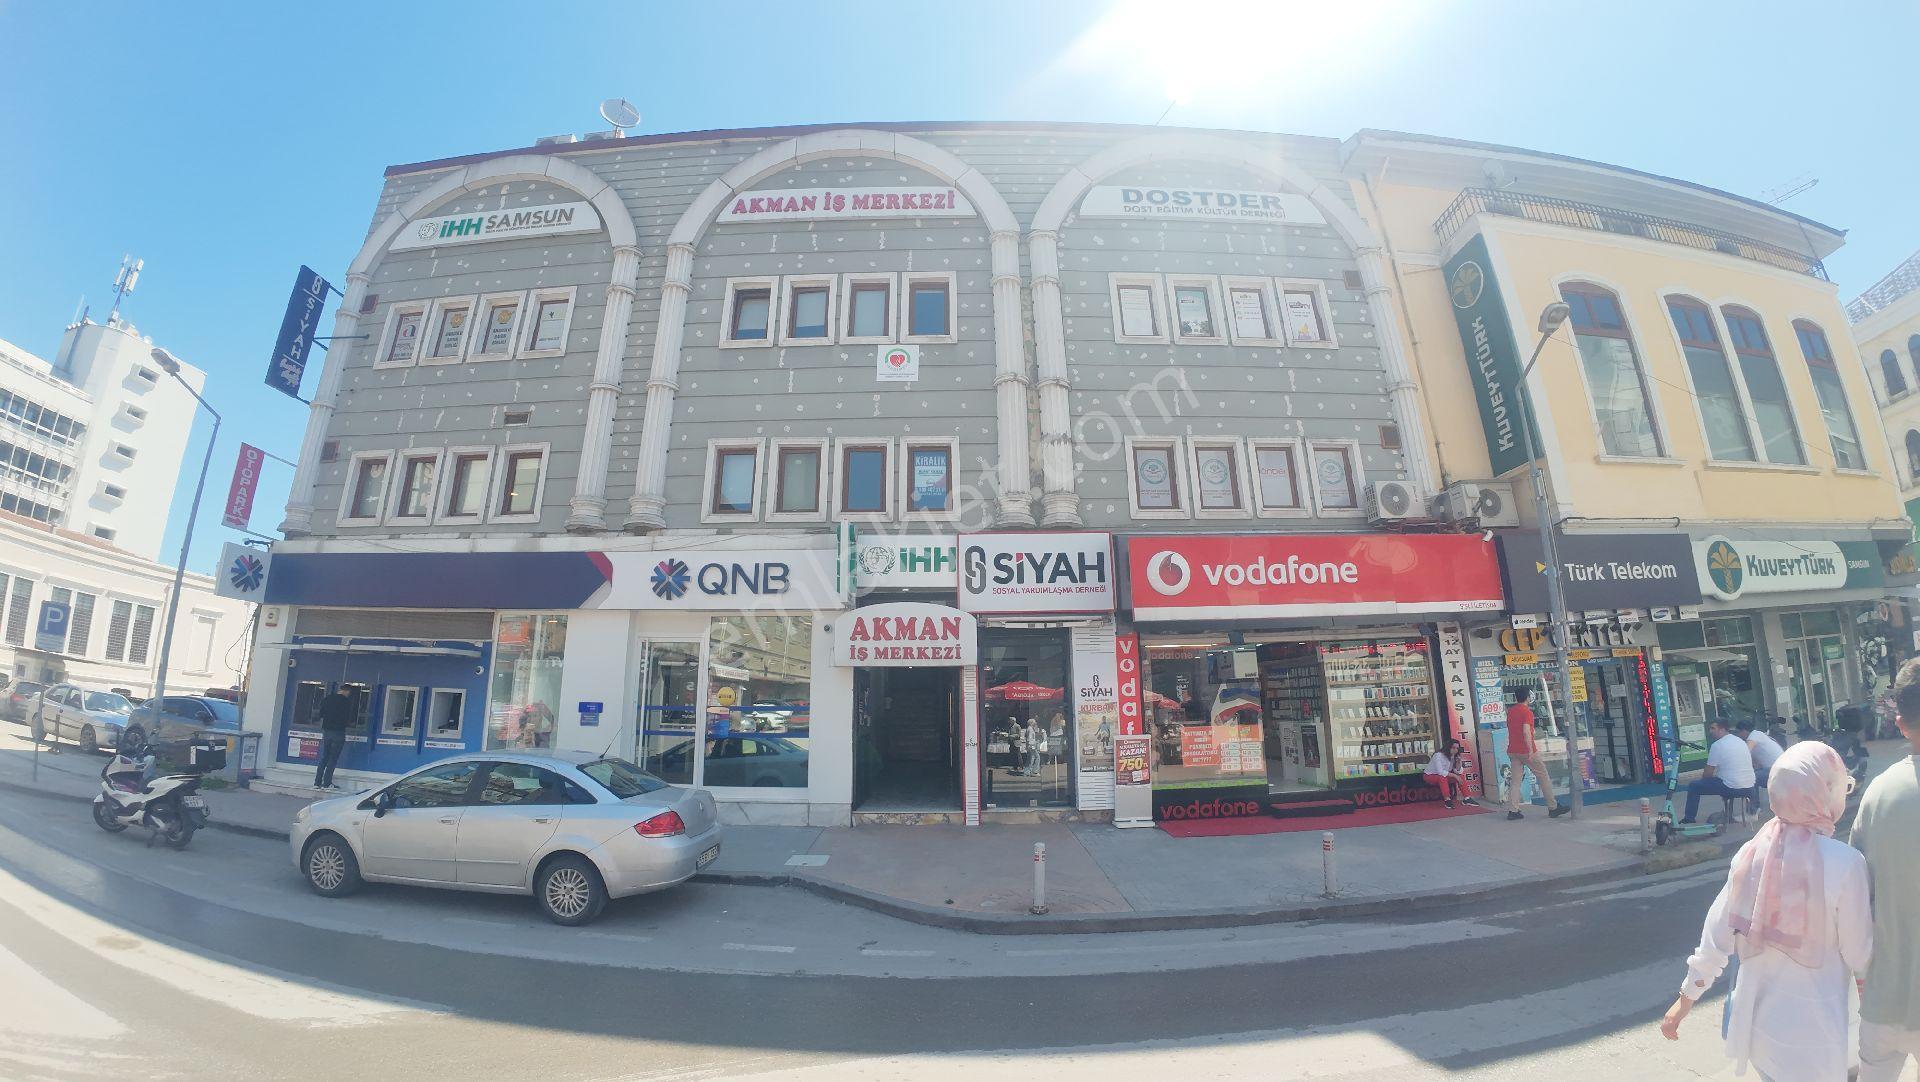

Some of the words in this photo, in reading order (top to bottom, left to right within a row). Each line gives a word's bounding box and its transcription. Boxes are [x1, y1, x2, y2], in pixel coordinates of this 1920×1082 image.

[731, 195, 817, 214] AKMAN
[823, 192, 845, 212] İŞ
[852, 190, 955, 210] MERKEZİ
[1121, 188, 1282, 209] DOSTDER
[1124, 205, 1152, 213] DOST
[486, 208, 575, 230] SAMSUN
[232, 450, 258, 518] OTOPARK
[697, 562, 791, 596] QNB
[1202, 555, 1358, 586] vodafone
[1564, 562, 1603, 583] Türk
[1607, 562, 1677, 580] Telekom
[992, 587, 1020, 595] SOSYAL
[1021, 587, 1073, 596] YARDIMLAŞMA
[1075, 585, 1107, 594] DERNEĞİ
[44, 606, 64, 631] P
[850, 616, 961, 641] AKMAN
[1501, 627, 1546, 652] CEP
[849, 645, 868, 661] İŞ
[874, 644, 962, 660] MERKEZİ
[1119, 745, 1147, 757] KAZAN!
[1119, 757, 1143, 772] 750
[1465, 773, 1479, 781] EP
[1353, 785, 1440, 808] vodafone
[1158, 797, 1260, 821] vodafone
